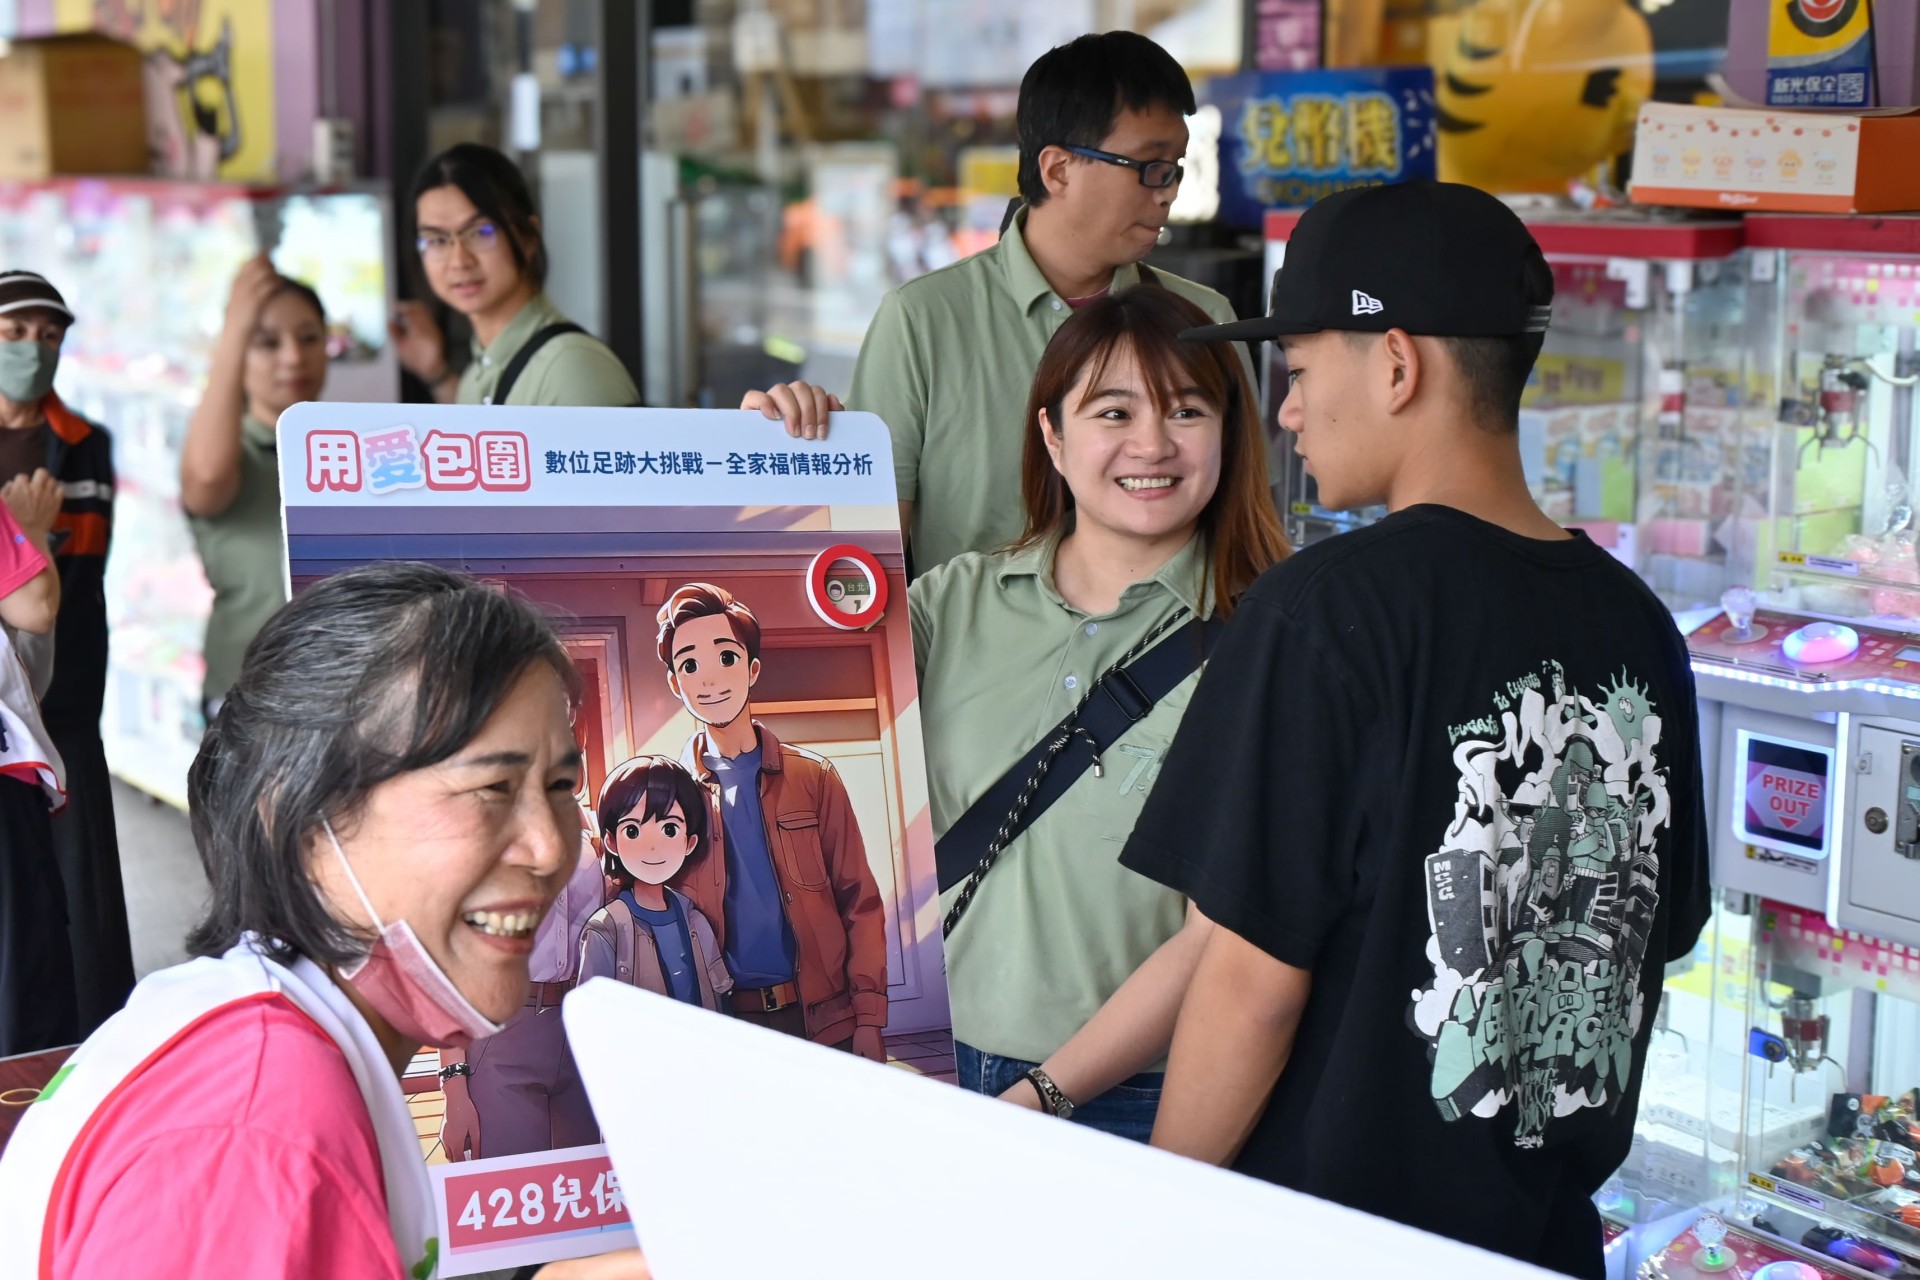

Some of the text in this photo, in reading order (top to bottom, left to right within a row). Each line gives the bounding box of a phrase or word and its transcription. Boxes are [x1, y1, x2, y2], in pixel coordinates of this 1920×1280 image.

[306, 426, 531, 494] 用愛包圍
[1763, 774, 1820, 799] PRIZE
[1770, 796, 1811, 817] OUT
